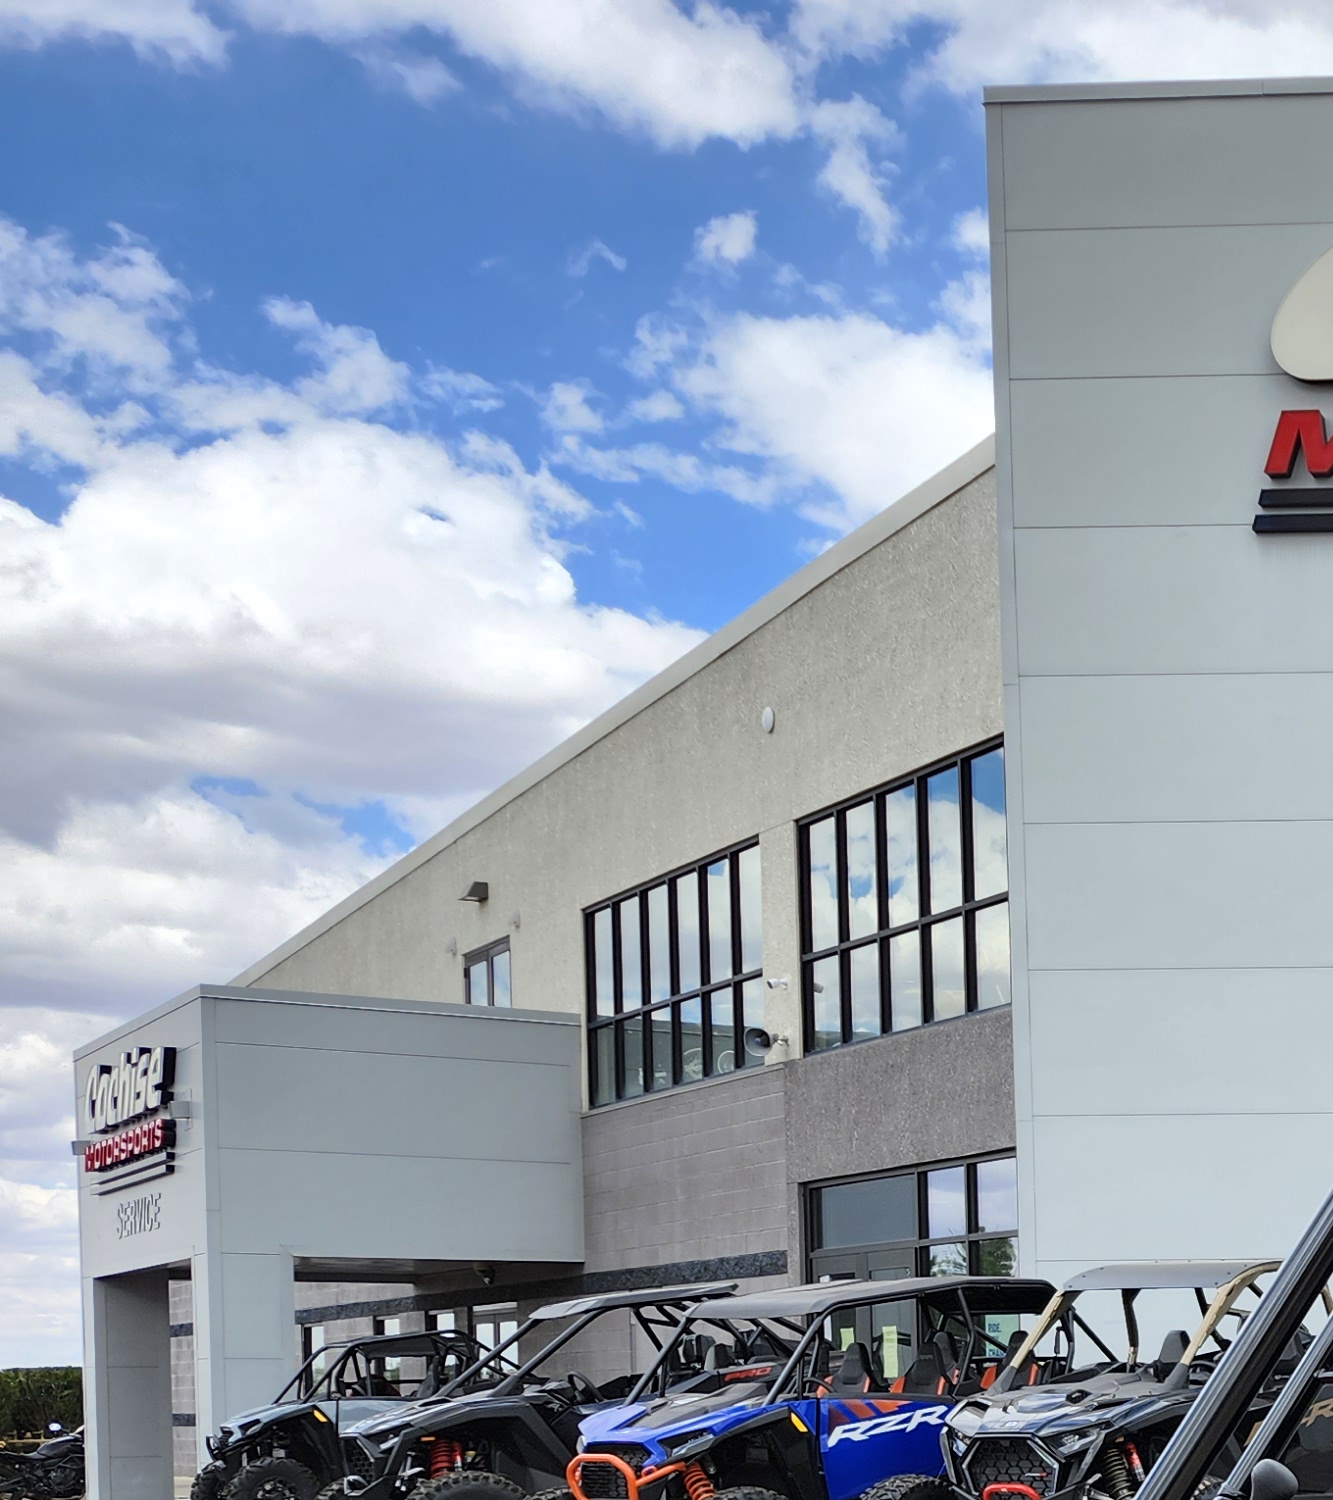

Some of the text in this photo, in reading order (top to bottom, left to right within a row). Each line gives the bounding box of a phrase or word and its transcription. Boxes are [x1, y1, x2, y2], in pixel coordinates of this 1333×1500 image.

[84, 1046, 170, 1135] Cochise
[84, 1118, 168, 1173] MOTORSPORTS
[116, 1192, 162, 1240] SERVICE
[723, 1365, 773, 1382] PRO
[827, 1404, 950, 1448] RZR
